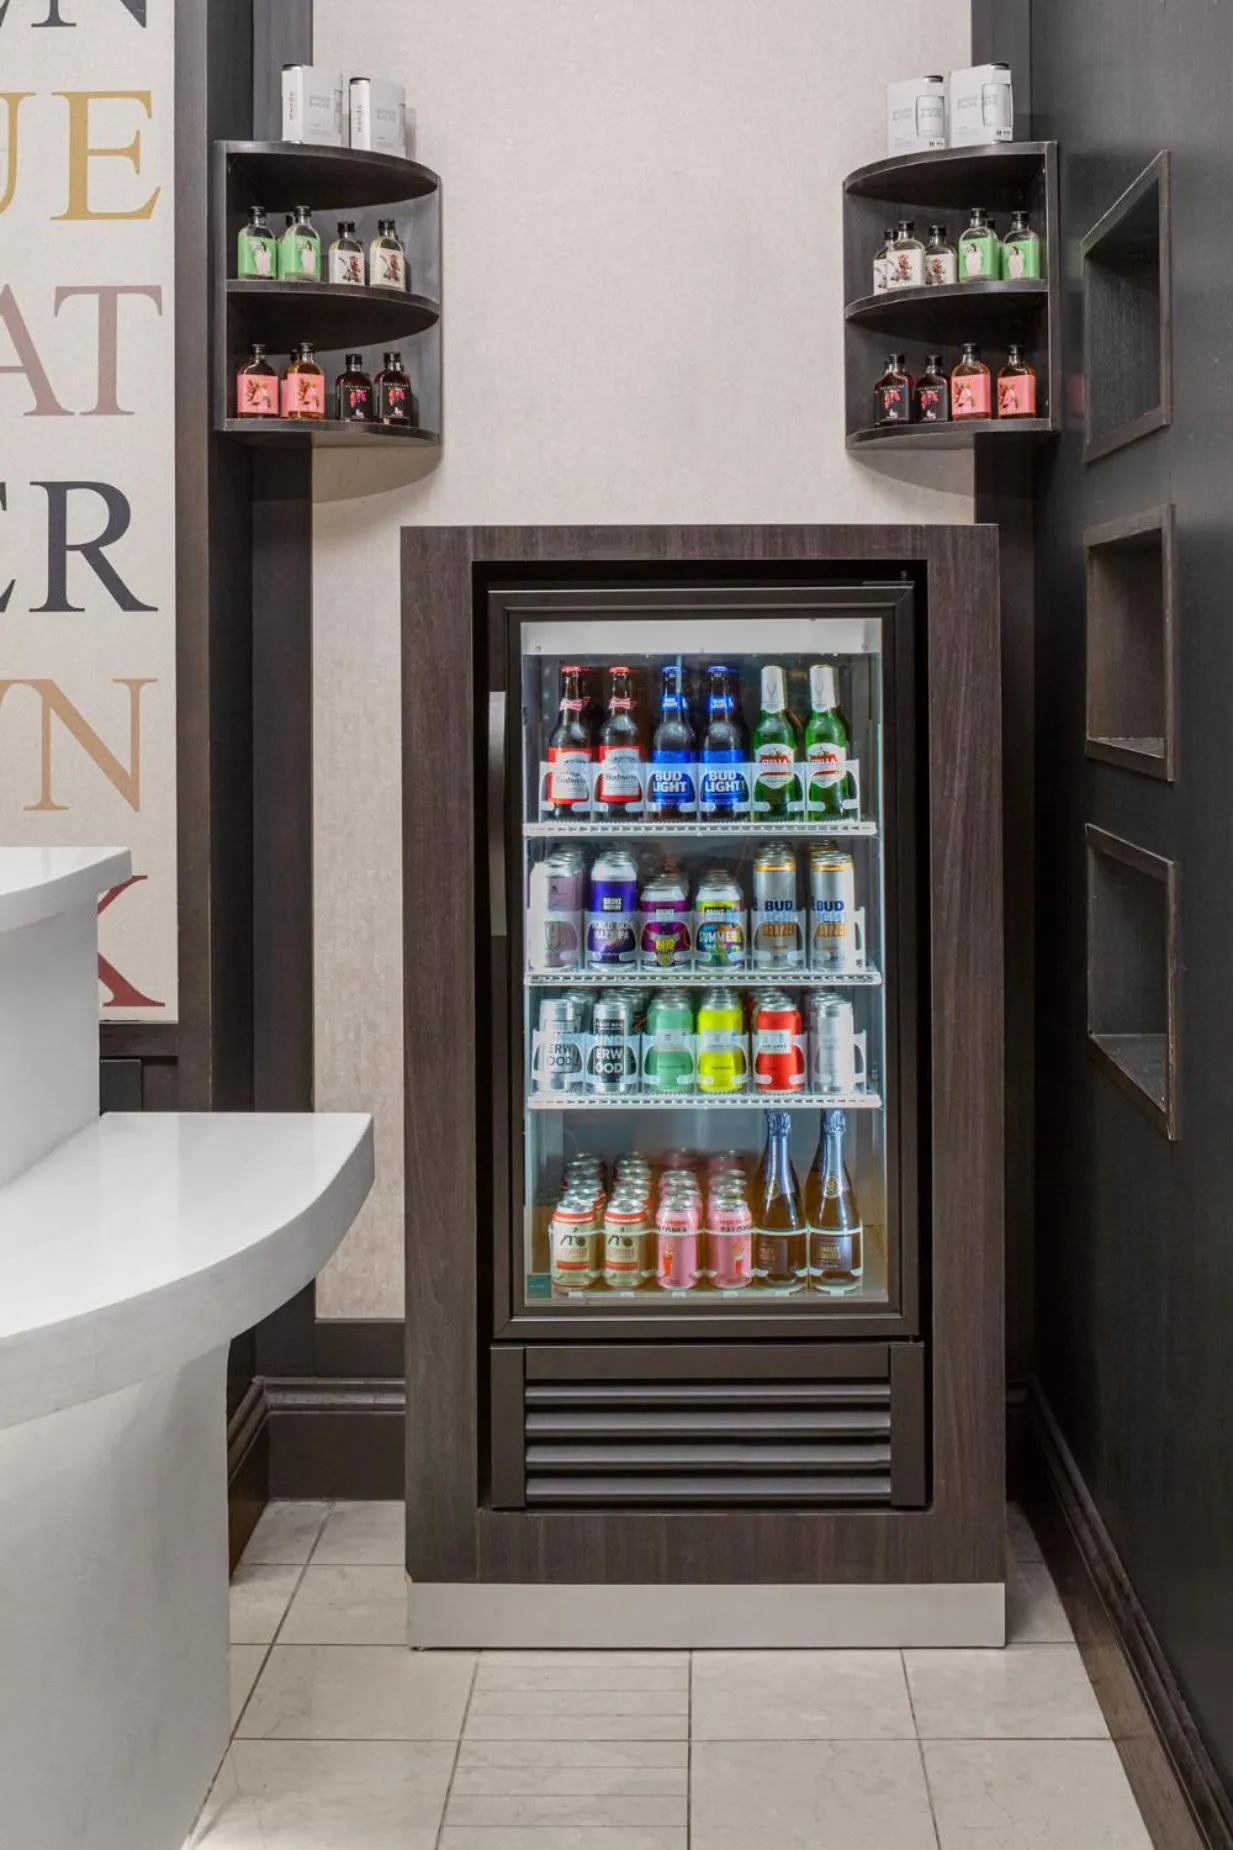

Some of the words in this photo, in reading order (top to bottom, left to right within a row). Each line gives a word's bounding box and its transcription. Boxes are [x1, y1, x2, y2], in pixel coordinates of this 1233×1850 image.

[0, 480, 159, 613] R
[0, 678, 158, 812] N
[655, 770, 683, 781] BUD
[708, 770, 738, 781] BUD
[652, 781, 688, 793] LIGHT
[704, 781, 741, 793] LIGHT
[764, 900, 793, 912] BUD
[816, 900, 845, 912] BUD
[596, 1047, 623, 1059] ERW
[595, 1062, 624, 1073] OOD
